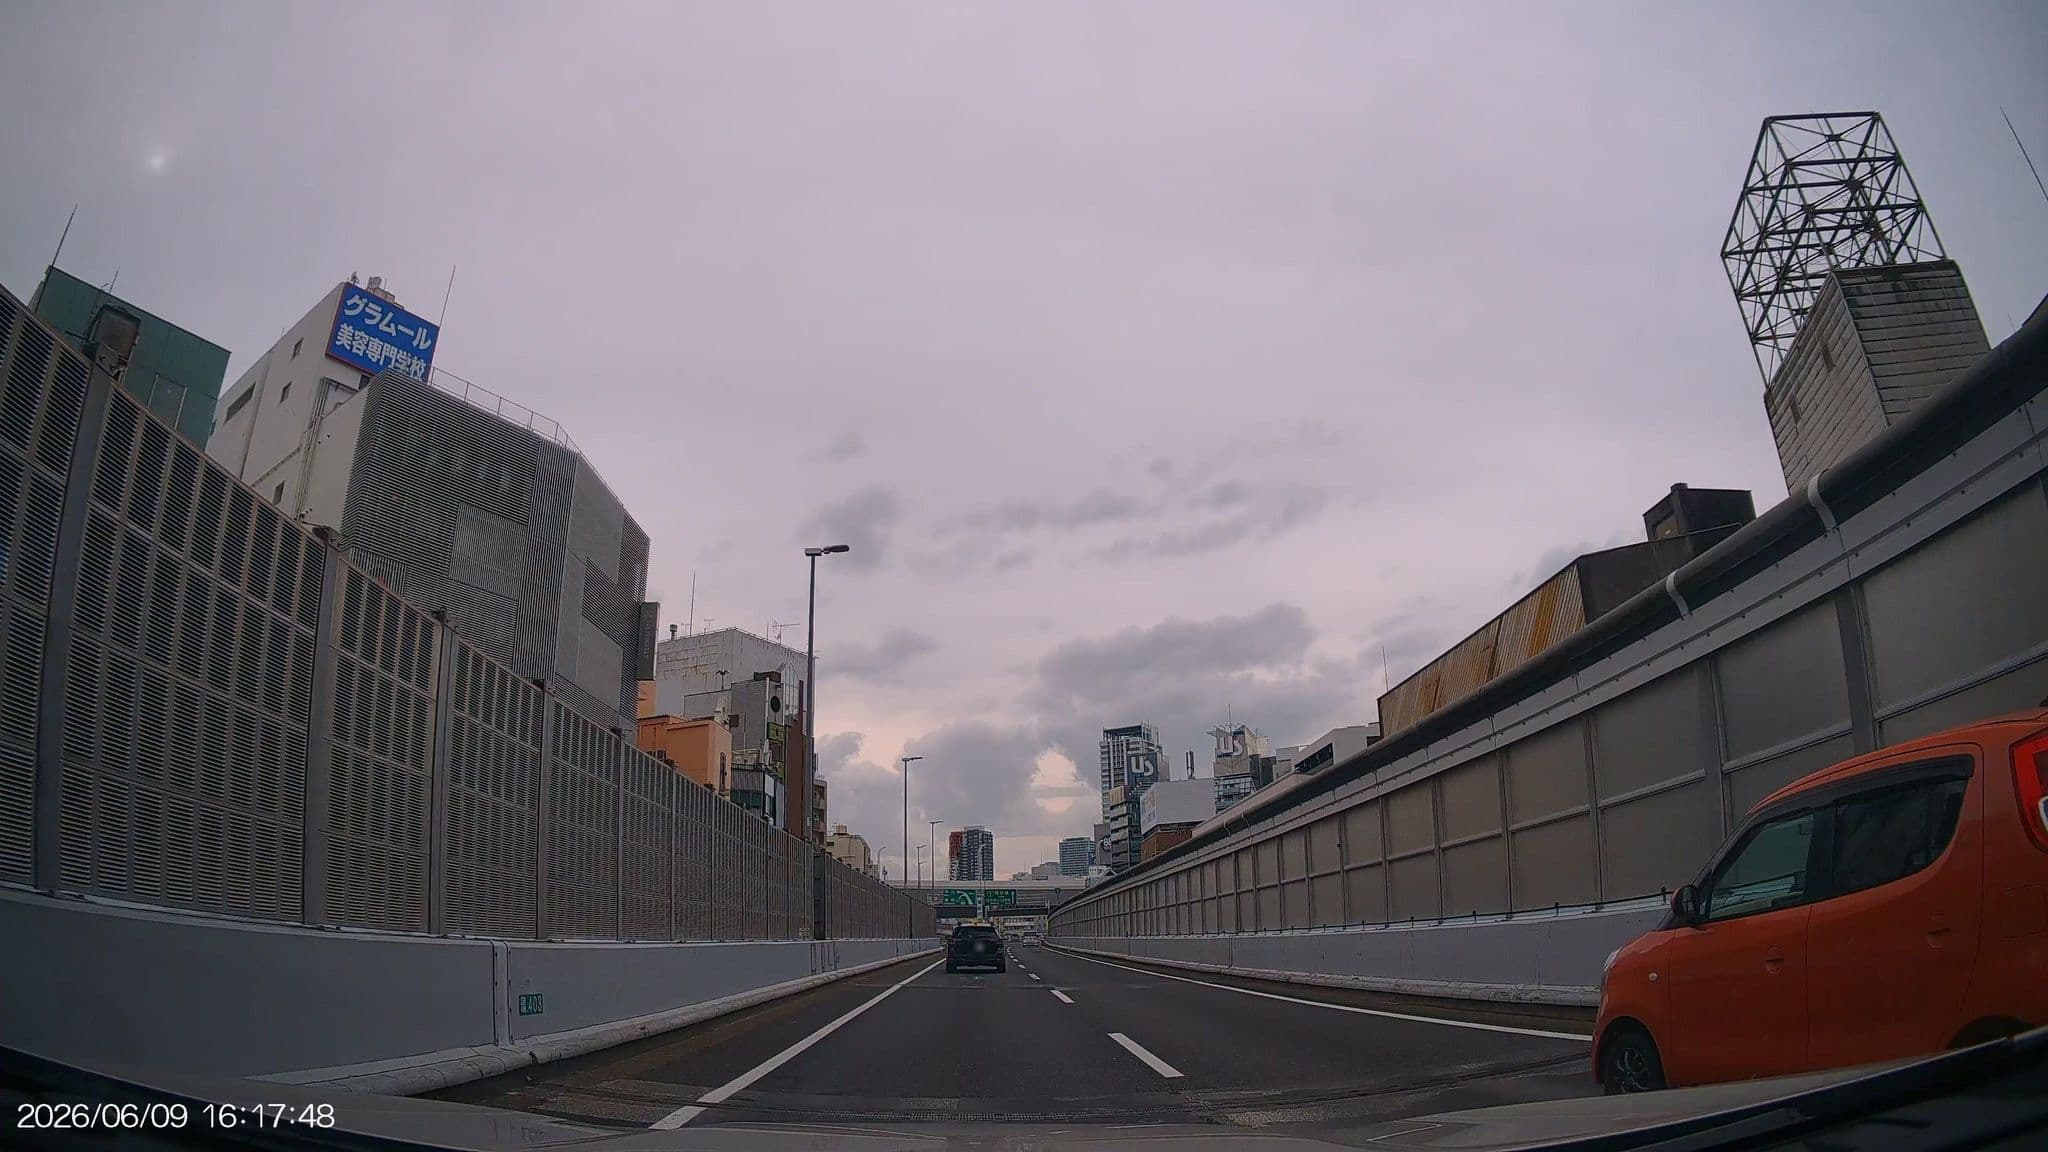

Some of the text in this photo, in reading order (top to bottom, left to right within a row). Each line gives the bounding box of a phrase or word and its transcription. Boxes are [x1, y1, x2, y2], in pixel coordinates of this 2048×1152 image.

[344, 294, 432, 350] グラムール
[335, 322, 426, 382] 美容専門学校
